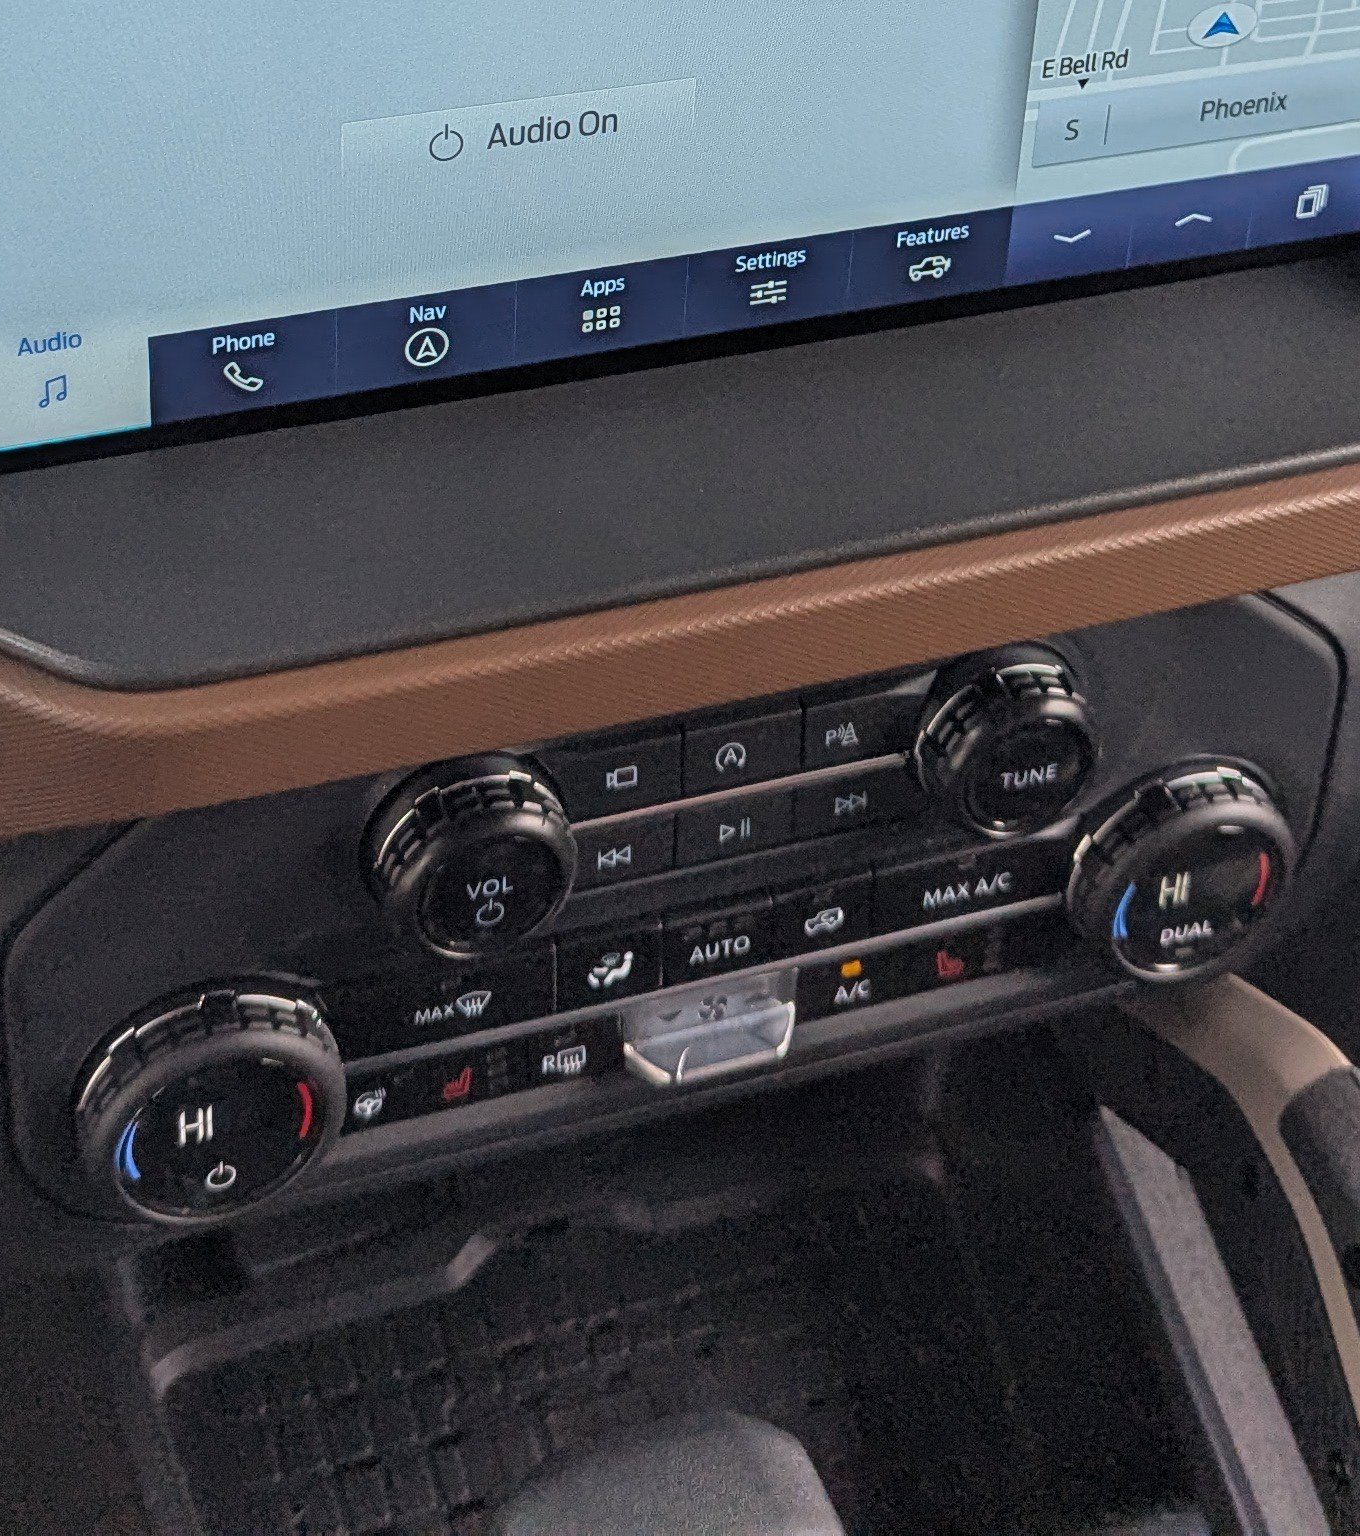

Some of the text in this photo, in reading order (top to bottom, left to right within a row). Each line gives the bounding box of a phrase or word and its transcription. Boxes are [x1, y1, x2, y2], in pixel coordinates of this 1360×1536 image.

[1042, 48, 1130, 79] E Bell Rd
[1199, 92, 1288, 123] Phoenix
[486, 109, 619, 151] Audio On
[1064, 119, 1080, 142] S
[895, 222, 970, 249] Features
[735, 247, 807, 273] Settings
[579, 275, 626, 298] Apps
[409, 304, 448, 324] Nav
[17, 330, 83, 357] Audio
[211, 329, 276, 356] Phone
[999, 762, 1060, 790] TUNE
[466, 877, 514, 901] VOL
[922, 871, 1013, 911] MAX A/C
[1158, 871, 1191, 910] HI
[1159, 919, 1213, 947] DUAL
[688, 934, 752, 965] AUTO
[833, 979, 871, 1006] A/C
[414, 1002, 456, 1027] MAX
[177, 1104, 214, 1149] HI
